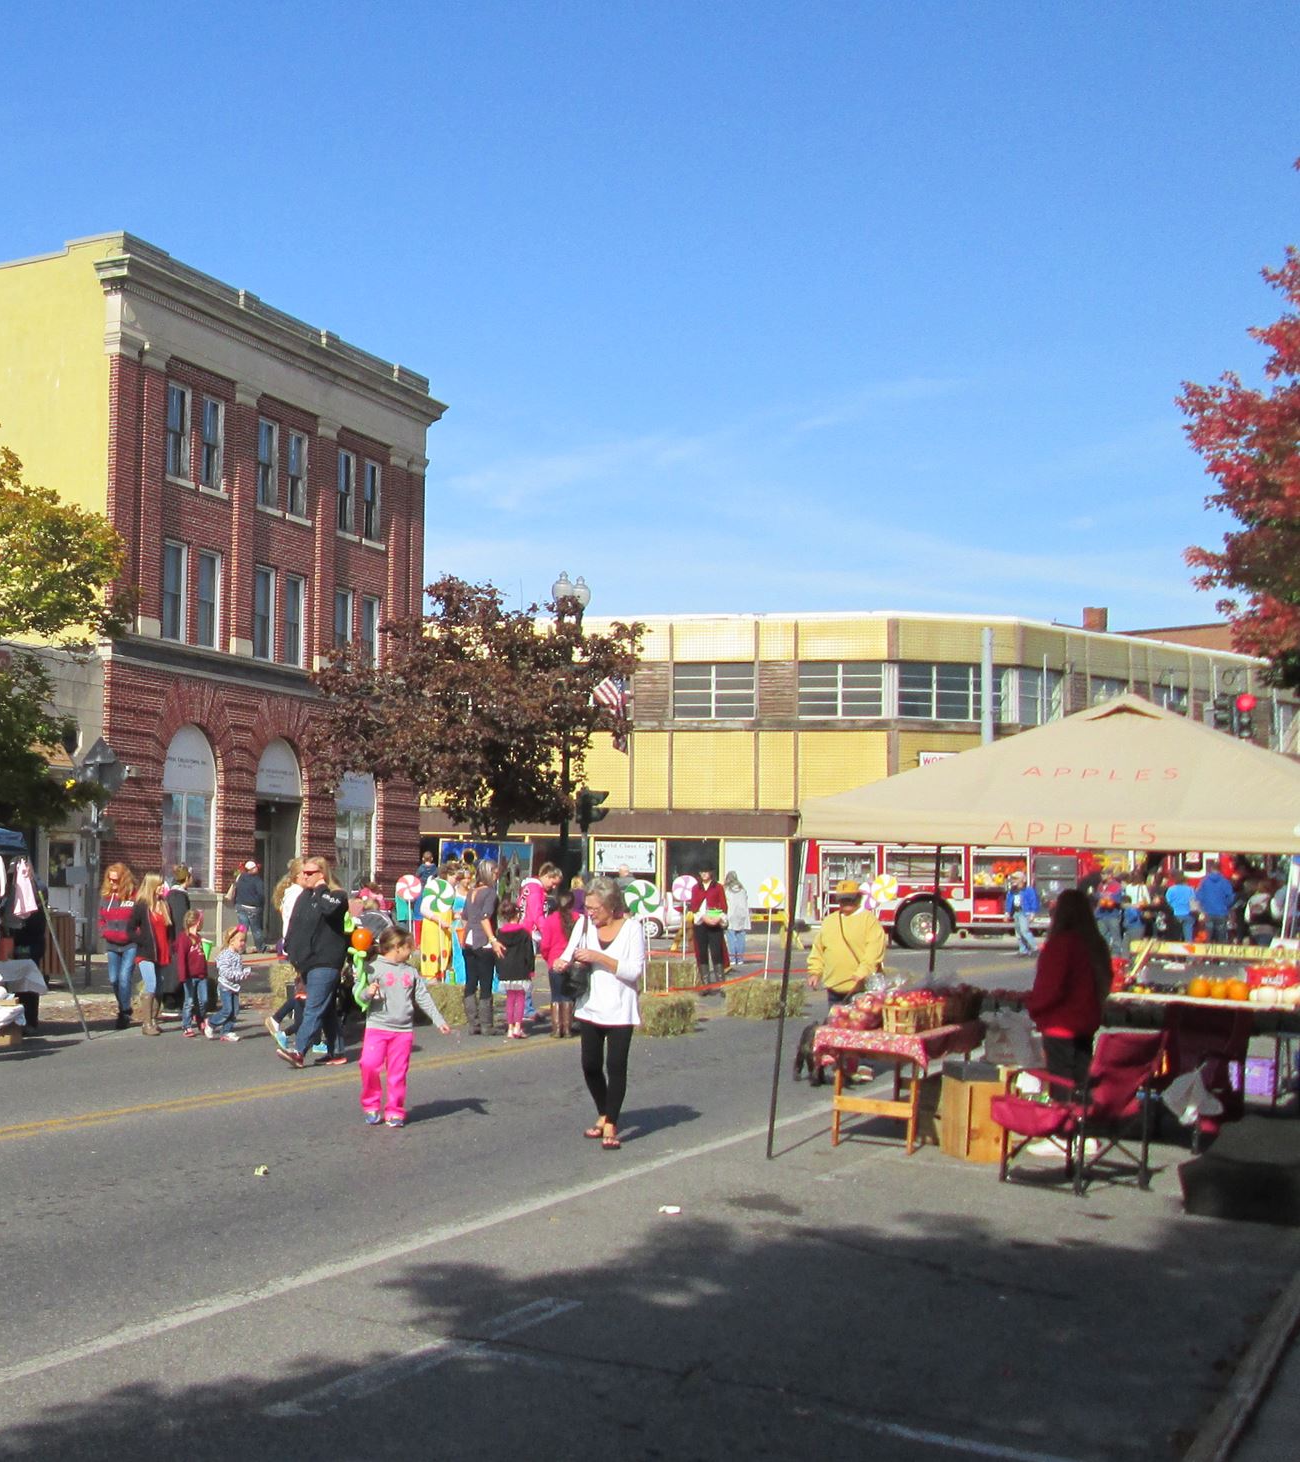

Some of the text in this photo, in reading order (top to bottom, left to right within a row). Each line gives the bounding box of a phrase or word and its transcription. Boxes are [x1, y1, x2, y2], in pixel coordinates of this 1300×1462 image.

[1021, 766, 1180, 781] APPLES
[993, 821, 1157, 845] APPLES
[1205, 943, 1246, 957] VILLAGE
